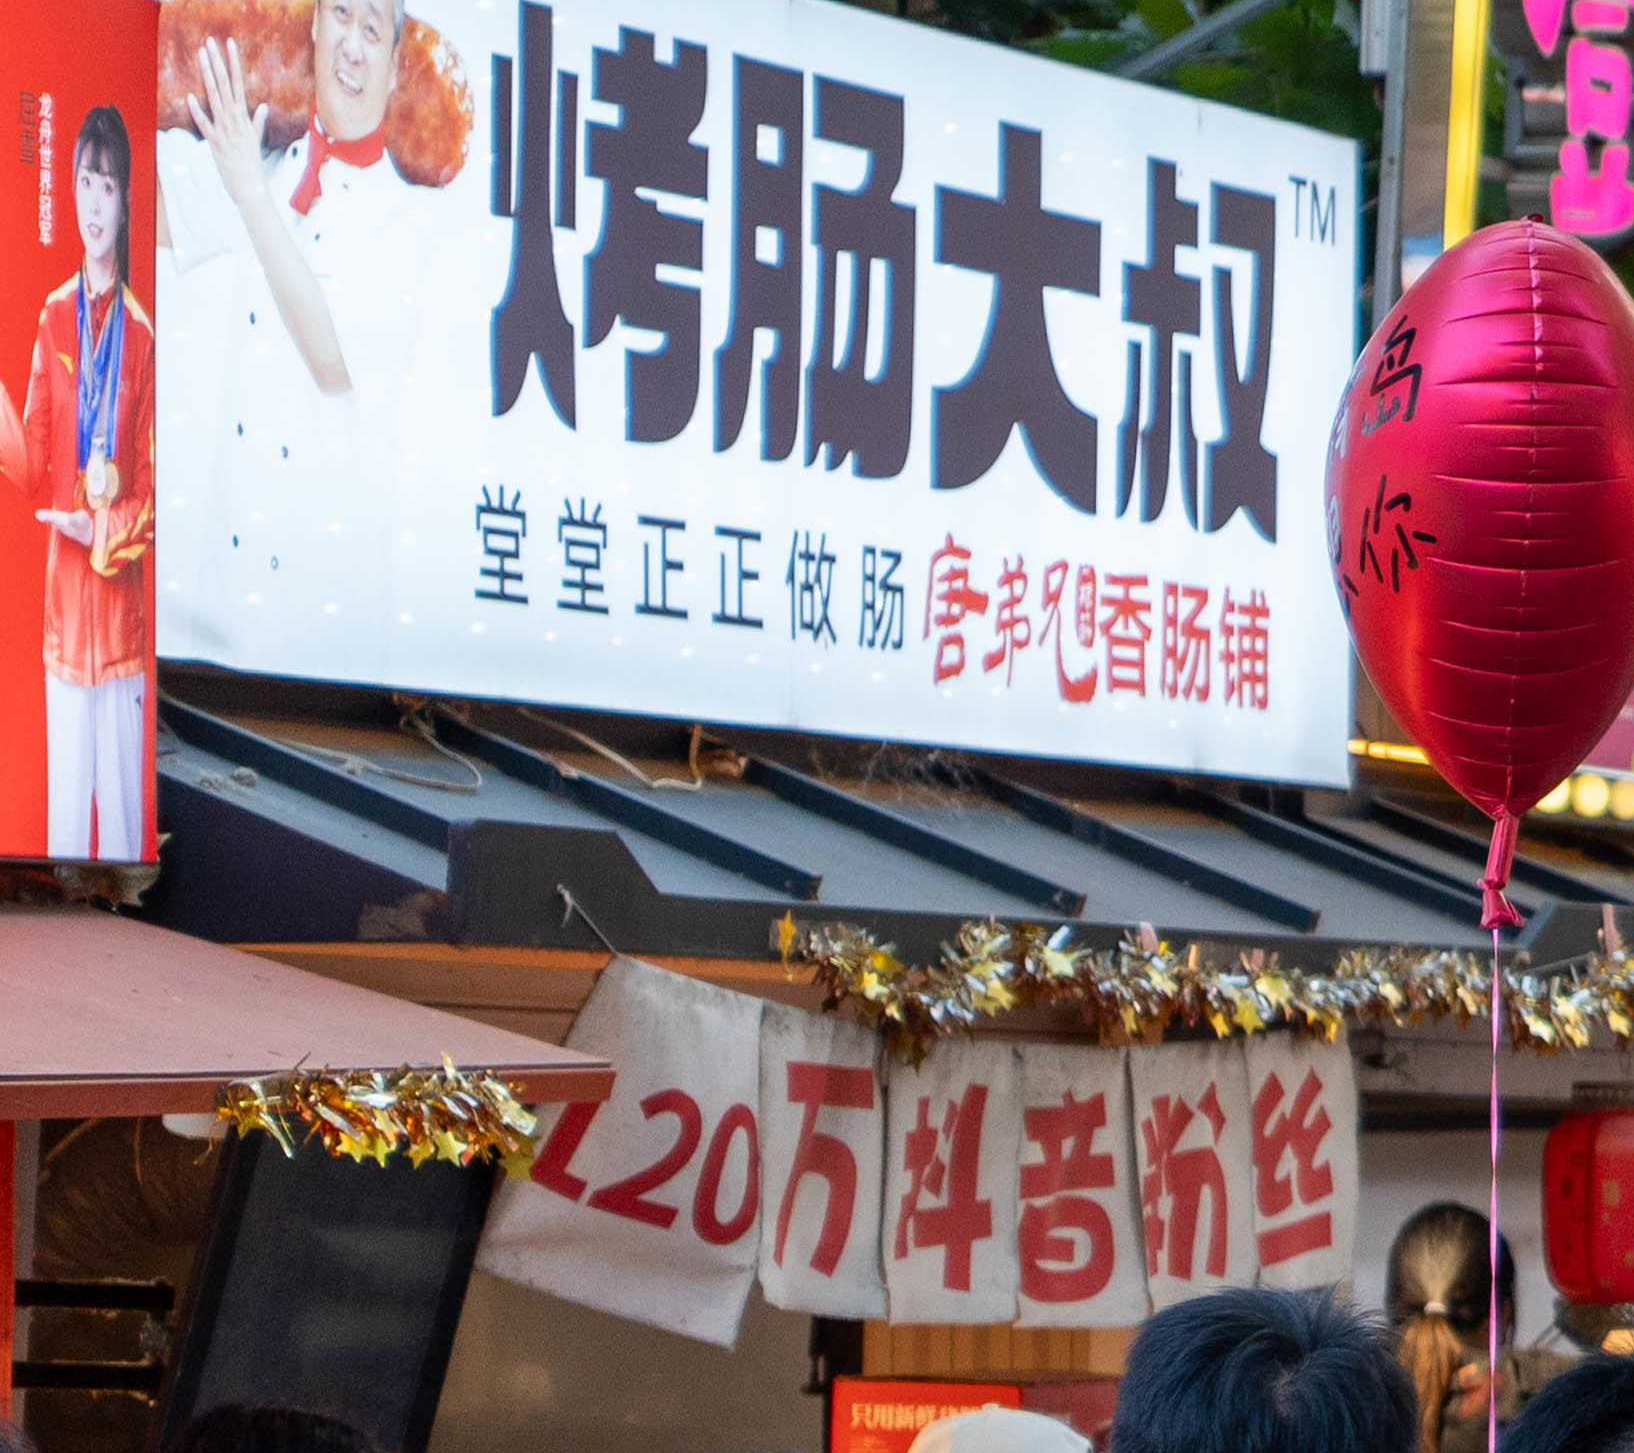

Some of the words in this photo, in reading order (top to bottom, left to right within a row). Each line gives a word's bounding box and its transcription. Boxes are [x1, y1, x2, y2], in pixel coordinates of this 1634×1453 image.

[1289, 175, 1338, 246] TM
[486, 0, 1279, 545] 烤肠大叔
[473, 483, 906, 652] 堂堂正正做肠
[851, 1401, 986, 1429] 只用新鲜
